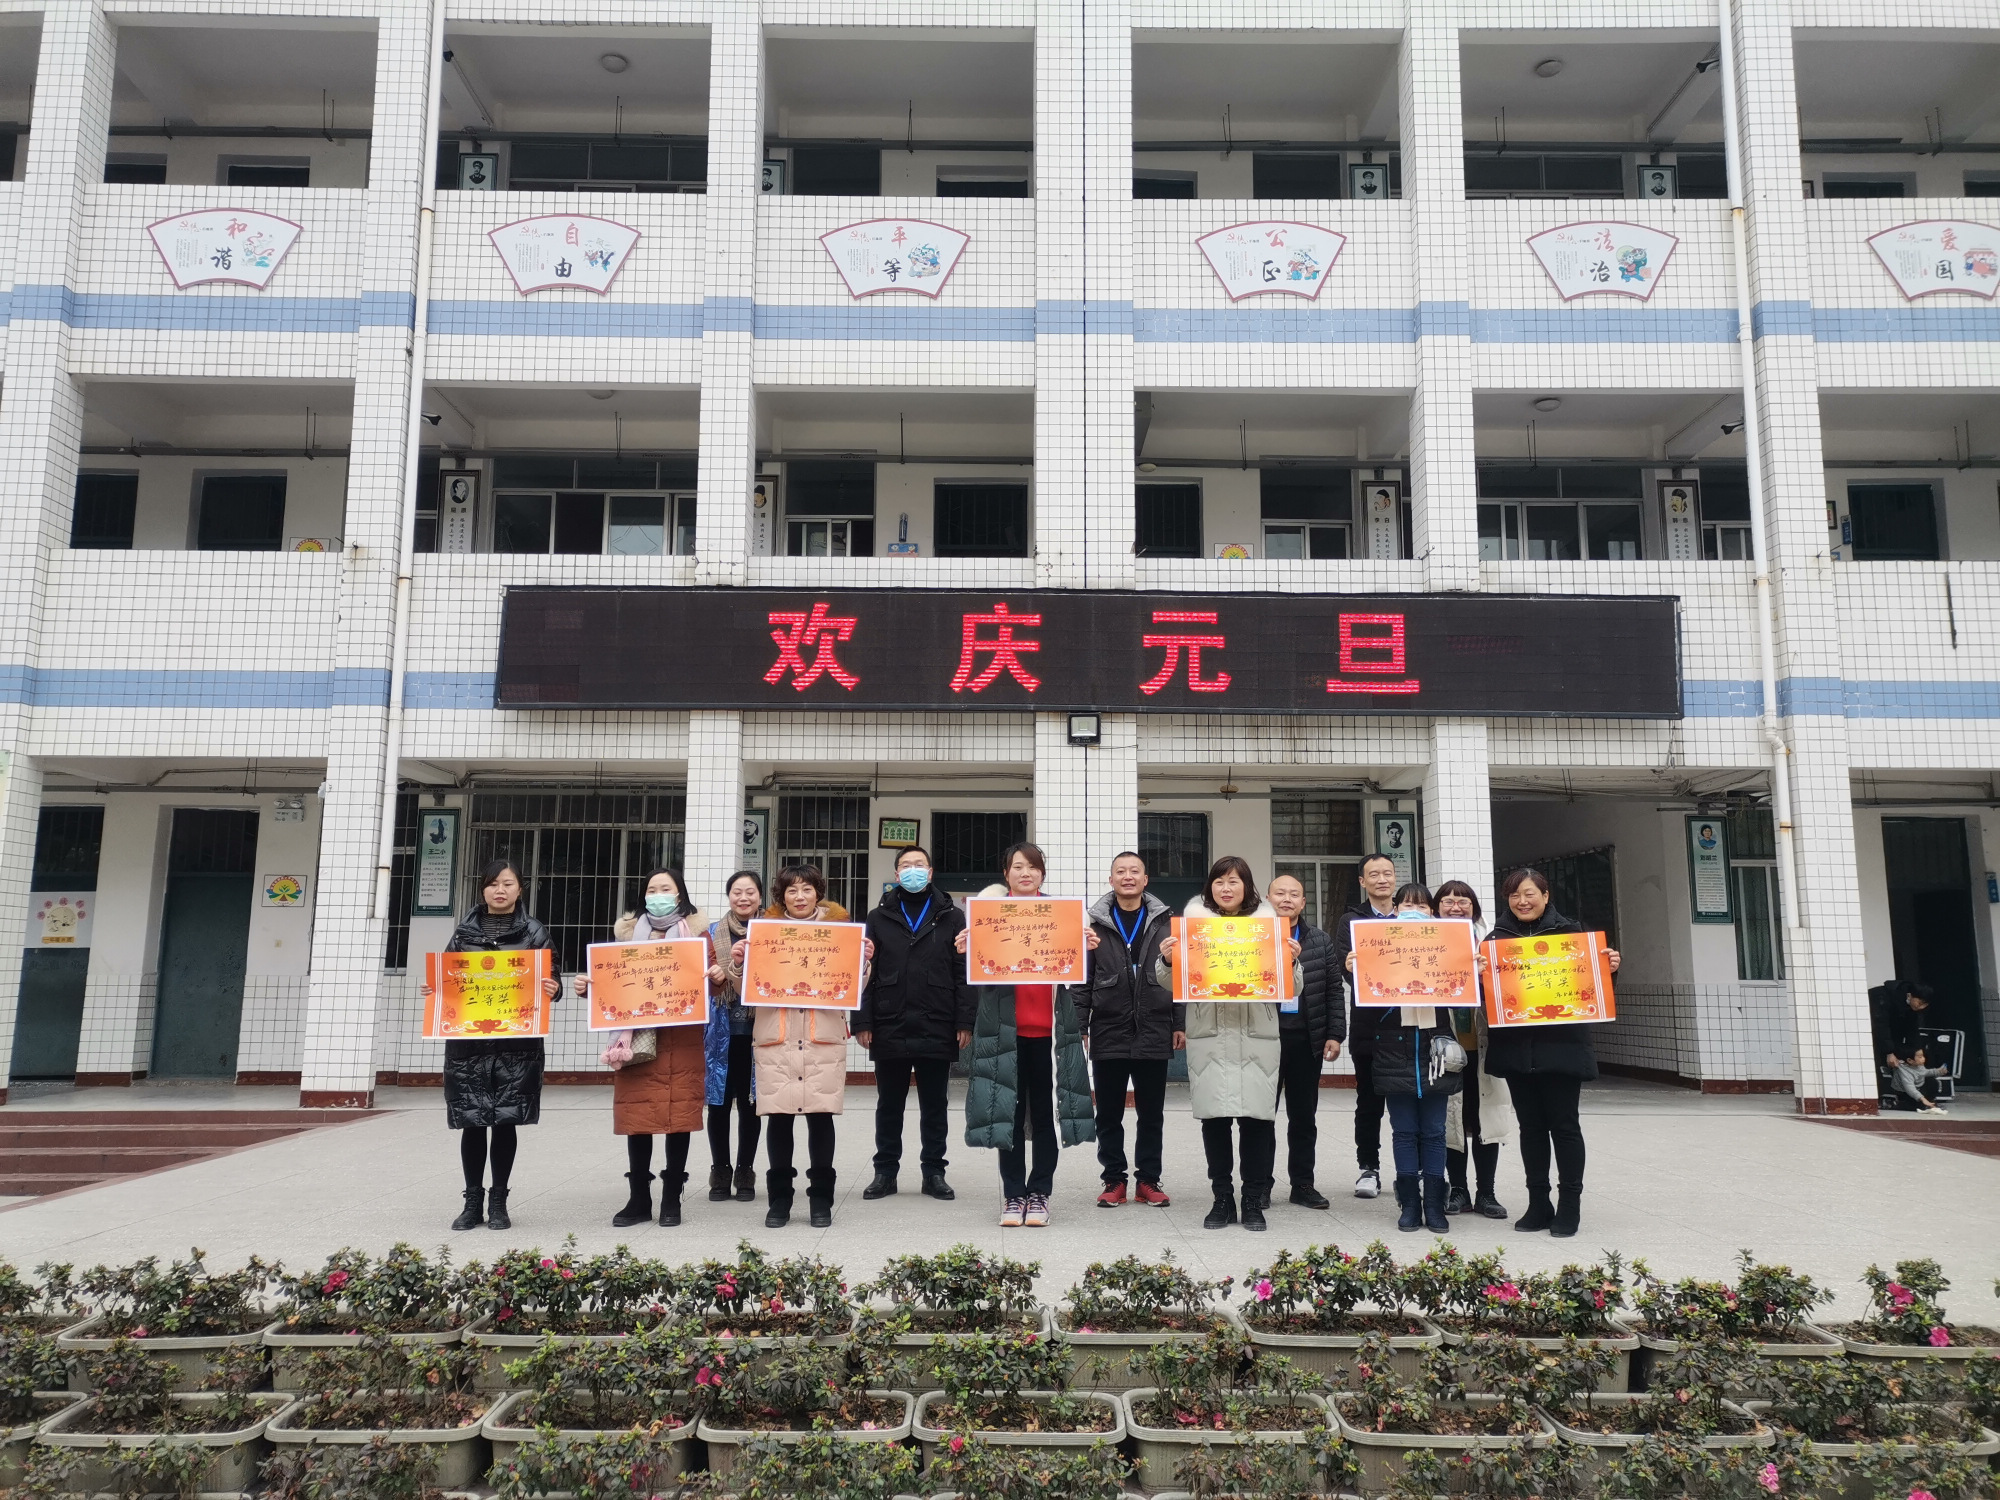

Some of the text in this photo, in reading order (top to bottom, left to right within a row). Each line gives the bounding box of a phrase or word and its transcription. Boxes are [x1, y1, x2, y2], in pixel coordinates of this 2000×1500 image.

[554, 221, 579, 278] 自由
[881, 226, 908, 282] 平等
[1590, 228, 1615, 282] 法治
[1936, 228, 1960, 281] 爱国
[763, 602, 1420, 696] 欢庆元旦
[1000, 933, 1050, 947] 一等奖
[779, 956, 826, 968] 一等奖
[1209, 958, 1248, 970] 二等奖
[1389, 954, 1438, 969] 一等奖
[622, 975, 672, 990] 一等奖
[1526, 977, 1569, 990] 二等奖
[466, 993, 509, 1006] 二等奖
